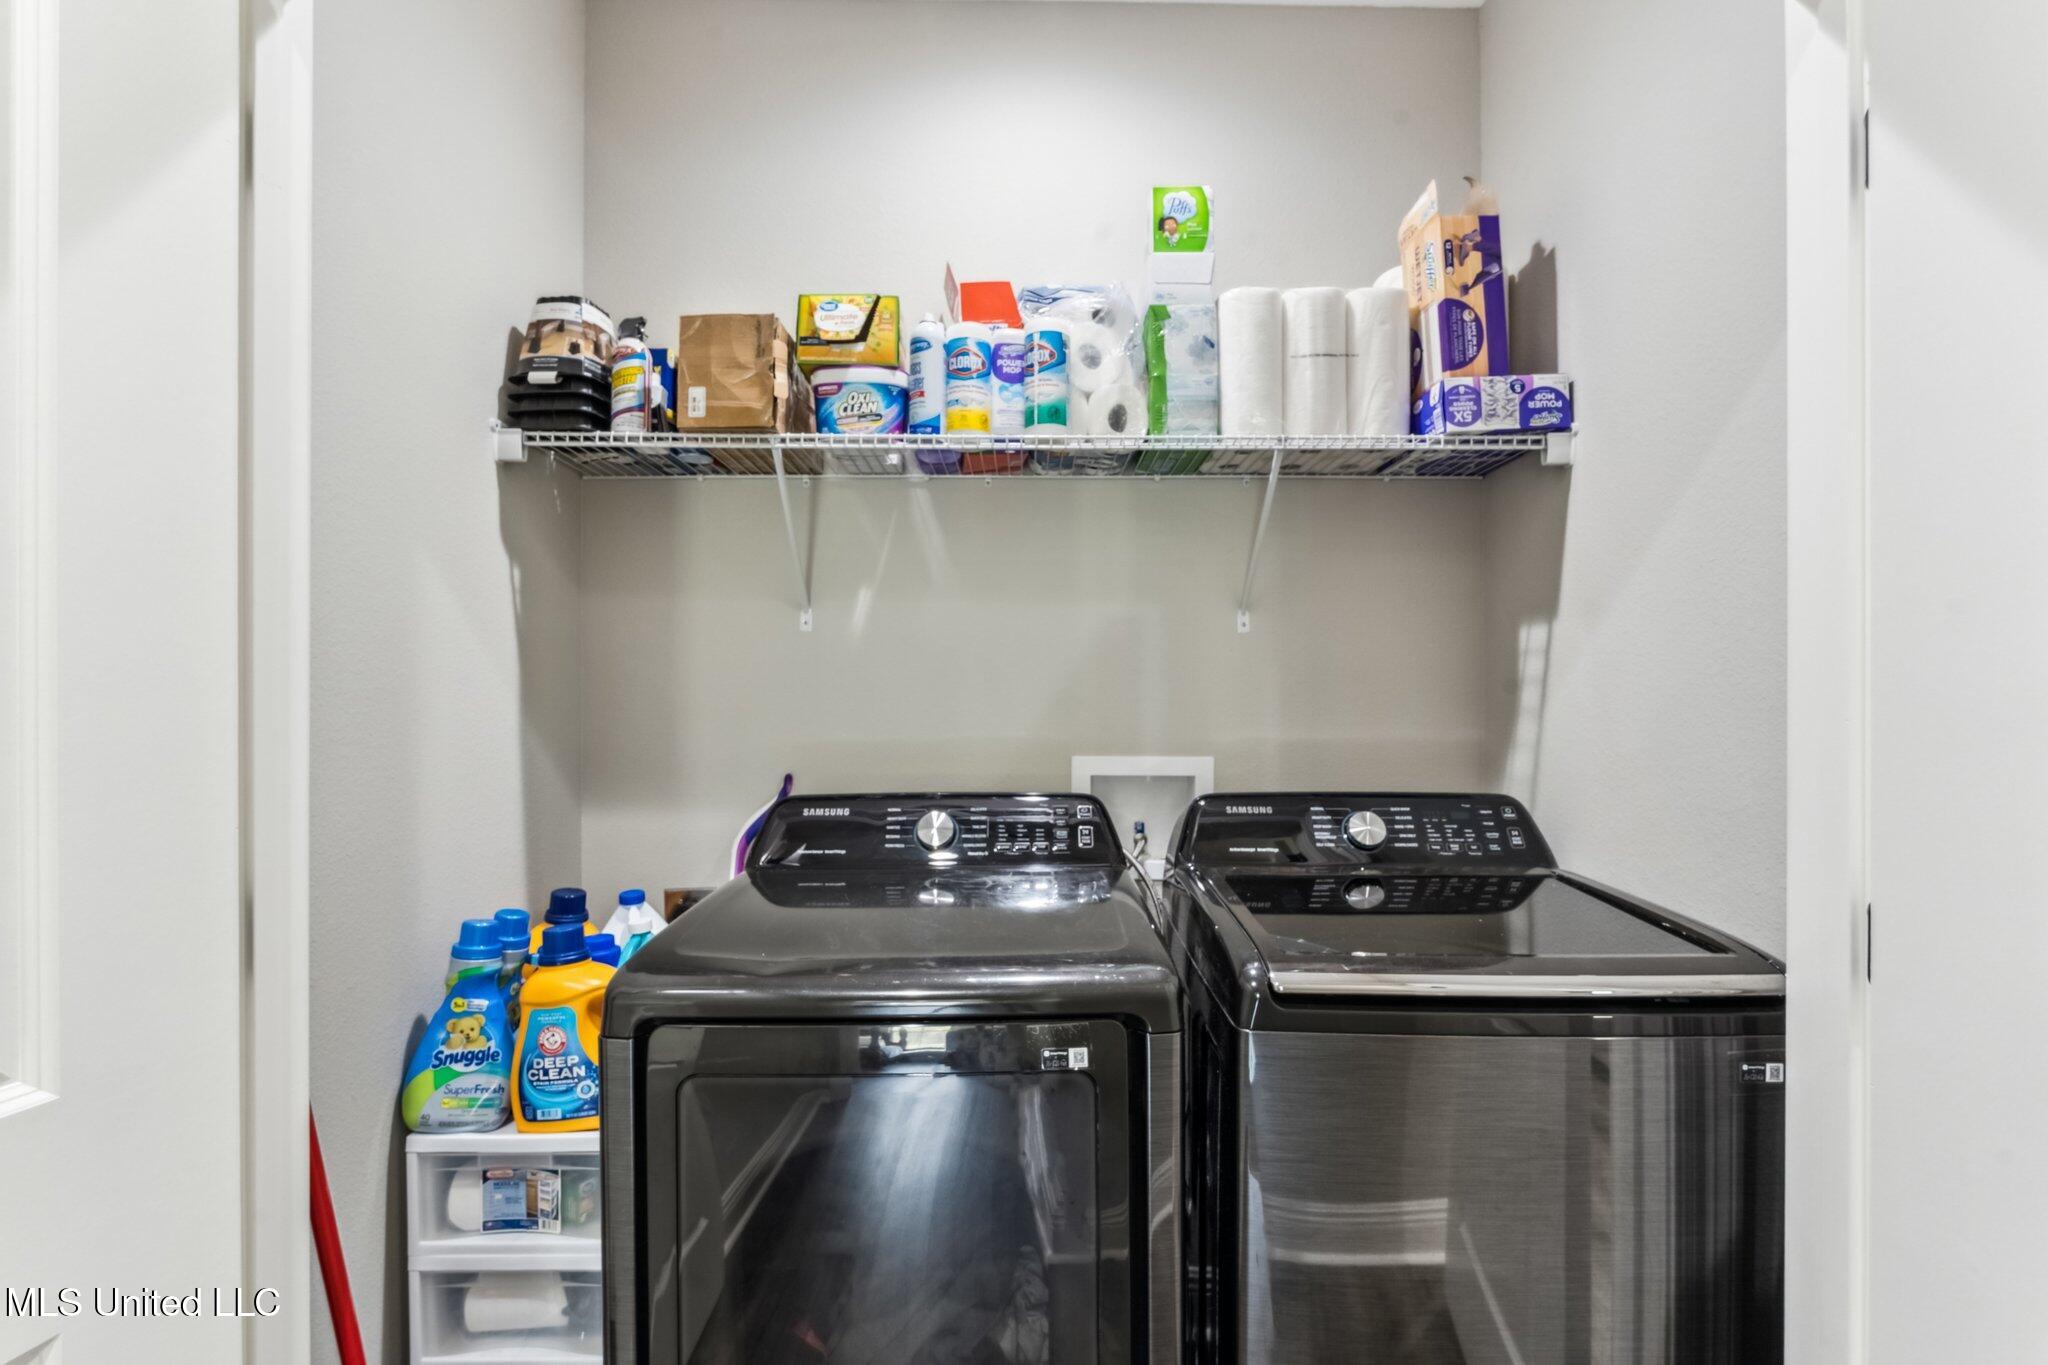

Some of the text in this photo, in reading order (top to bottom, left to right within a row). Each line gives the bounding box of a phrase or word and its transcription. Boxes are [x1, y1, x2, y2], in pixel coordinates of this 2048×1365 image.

[1168, 196, 1192, 217] Puffs
[1425, 241, 1436, 293] Swiffer
[1414, 245, 1423, 303] WETJET
[1003, 366, 1022, 374] MOP
[847, 391, 870, 403] OXI
[1535, 392, 1556, 401] MOP
[839, 402, 877, 416] CLEAN
[1528, 400, 1562, 409] POWER
[1454, 411, 1472, 422] 5X
[803, 808, 850, 816] SAMSUNG
[1226, 806, 1273, 814] SAMSUNG
[431, 1047, 501, 1069] Snuggle
[533, 1055, 580, 1070] DEEP
[527, 1065, 586, 1081] CLEAN
